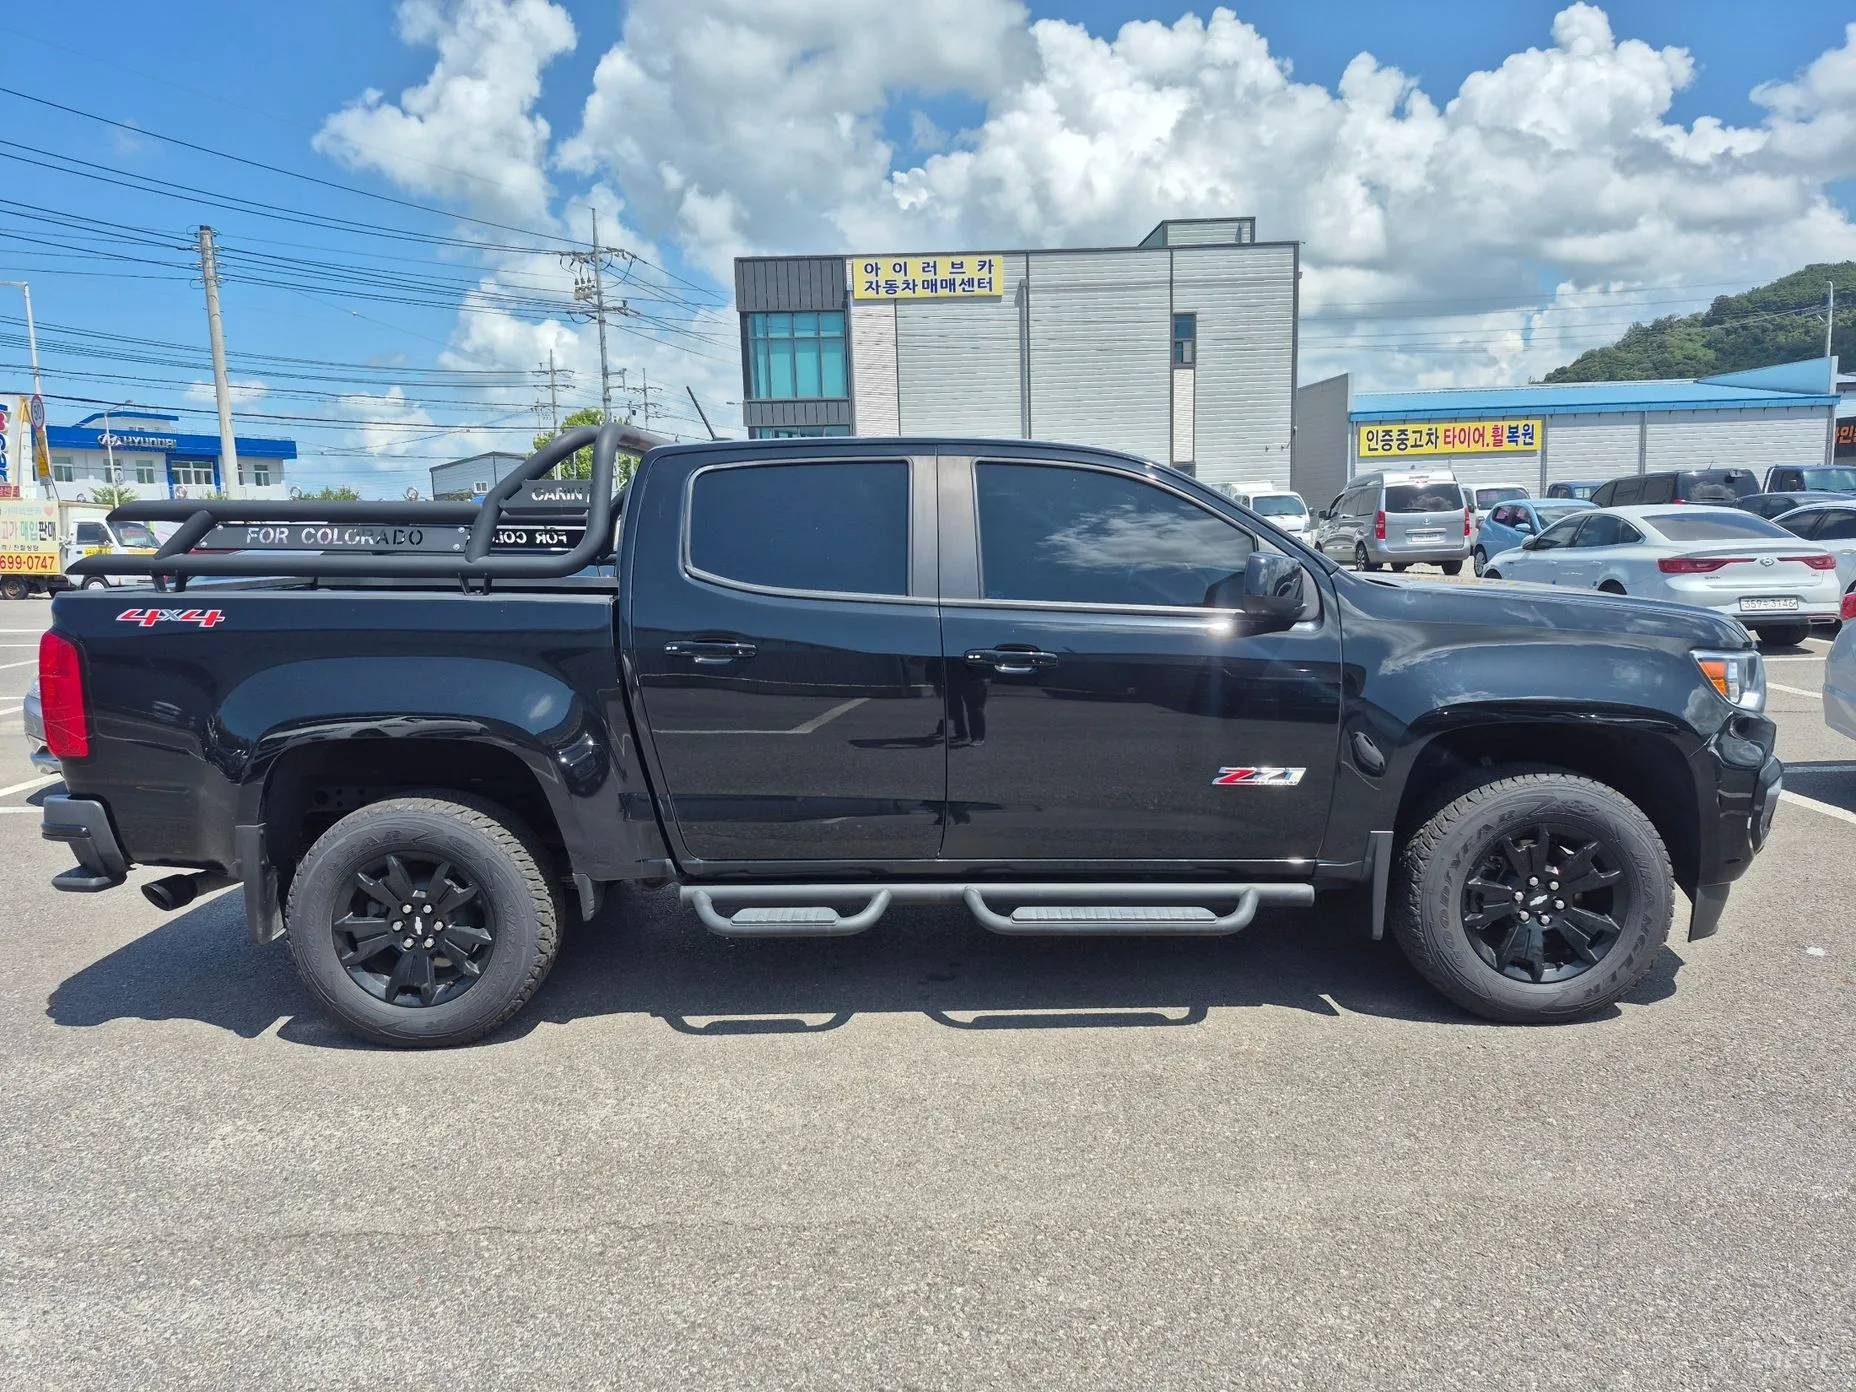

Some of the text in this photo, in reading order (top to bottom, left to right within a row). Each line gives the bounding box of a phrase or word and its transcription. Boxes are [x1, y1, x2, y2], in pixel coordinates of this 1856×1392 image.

[122, 435, 177, 450] HYUNDAI
[1366, 426, 1440, 452] 인증중고차
[246, 526, 425, 547] FOR COLORADO
[1211, 766, 1307, 786] Z71
